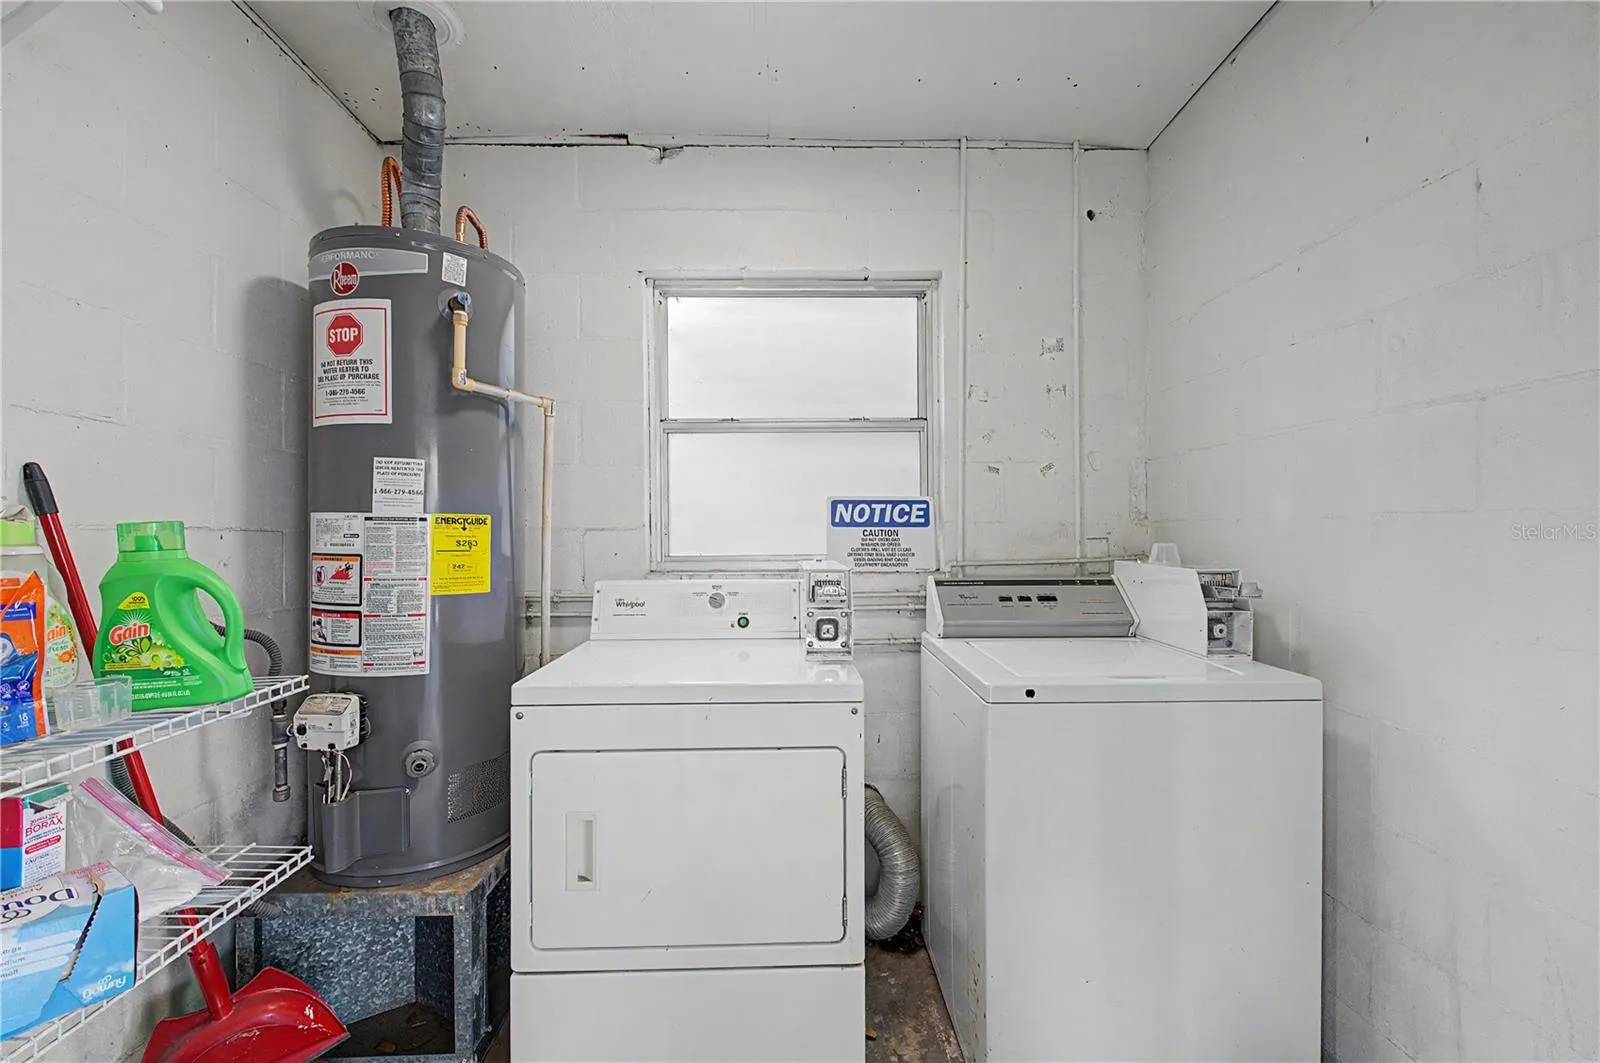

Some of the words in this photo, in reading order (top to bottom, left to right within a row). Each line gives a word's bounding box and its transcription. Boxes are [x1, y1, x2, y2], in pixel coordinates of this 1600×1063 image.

[333, 263, 357, 290] Rheem
[330, 328, 358, 343] STOP
[834, 503, 926, 523] NOTICE
[862, 529, 899, 537] CAUTION
[48, 626, 66, 641] ain
[110, 623, 149, 645] Gain
[25, 816, 63, 837] BORAX
